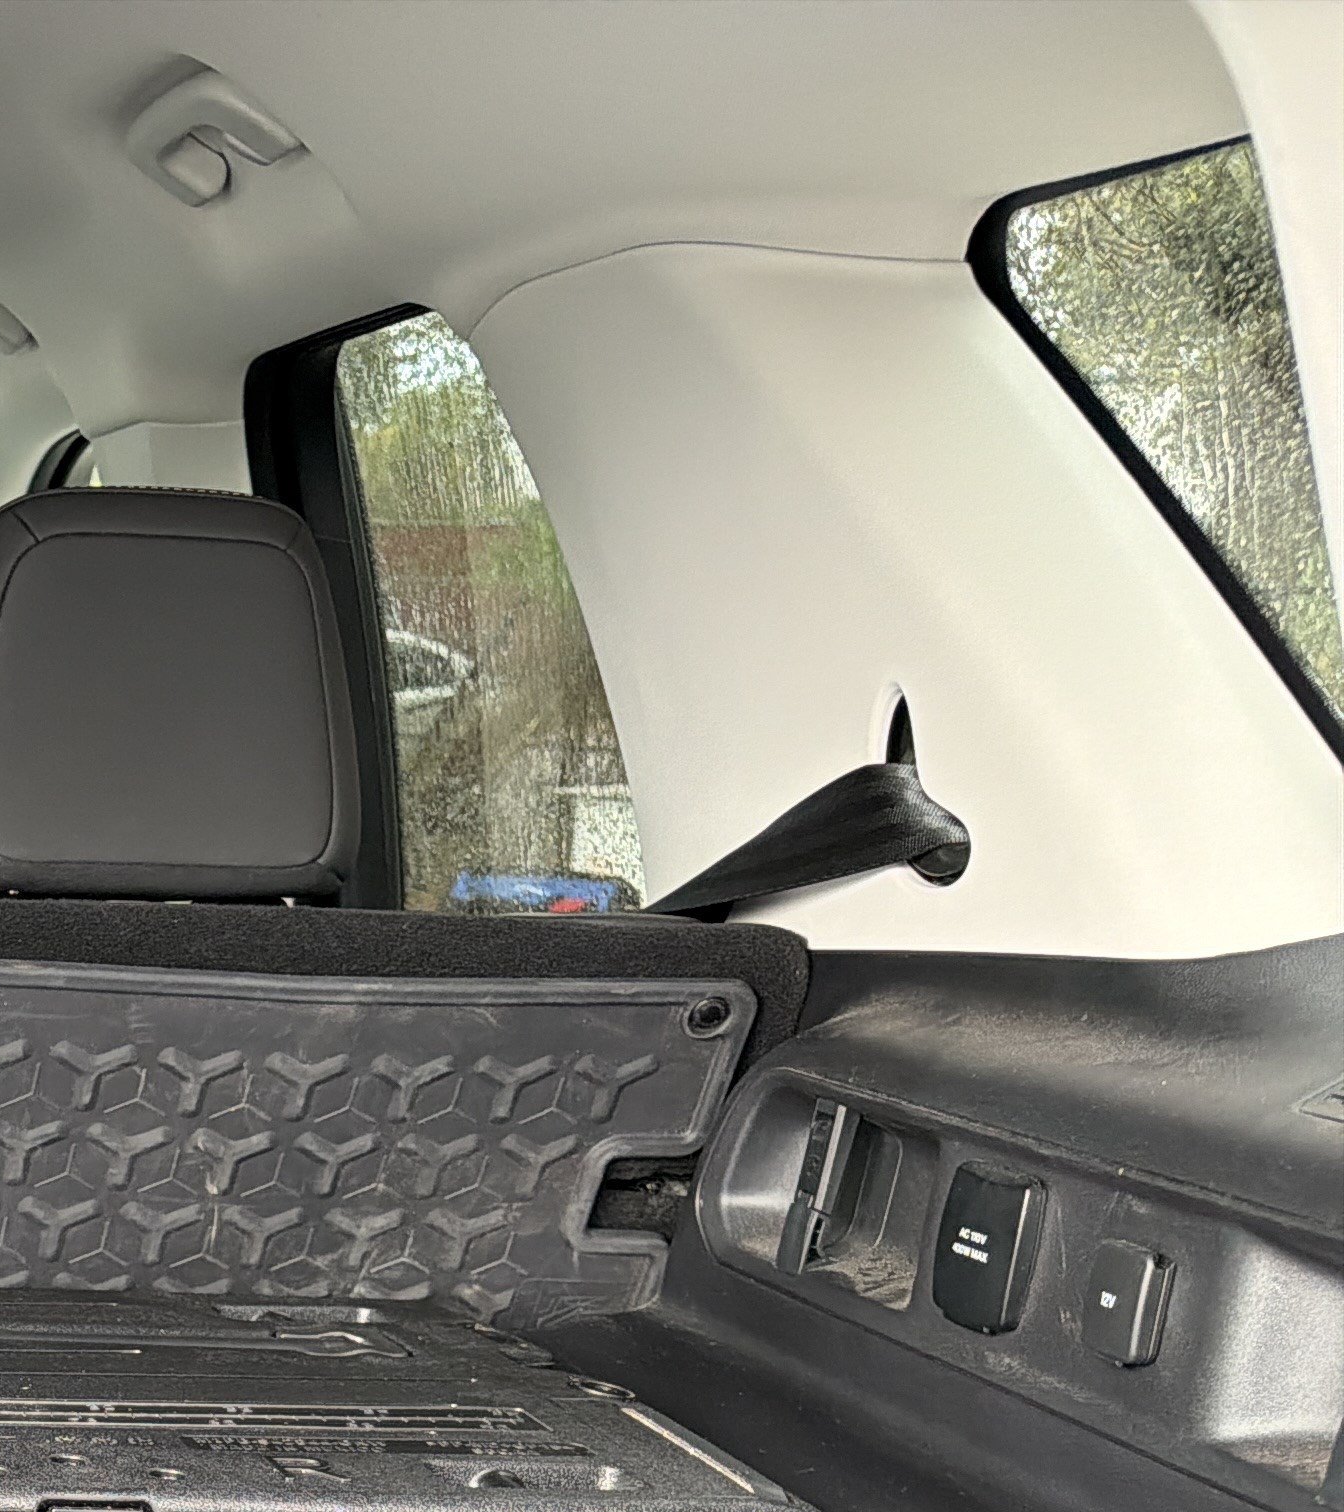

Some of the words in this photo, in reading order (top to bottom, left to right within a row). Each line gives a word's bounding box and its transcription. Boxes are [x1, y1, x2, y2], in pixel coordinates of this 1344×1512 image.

[959, 1227, 971, 1240] AC
[971, 1248, 989, 1264] MAX
[1100, 1291, 1117, 1309] 12V
[265, 1454, 352, 1484] R
